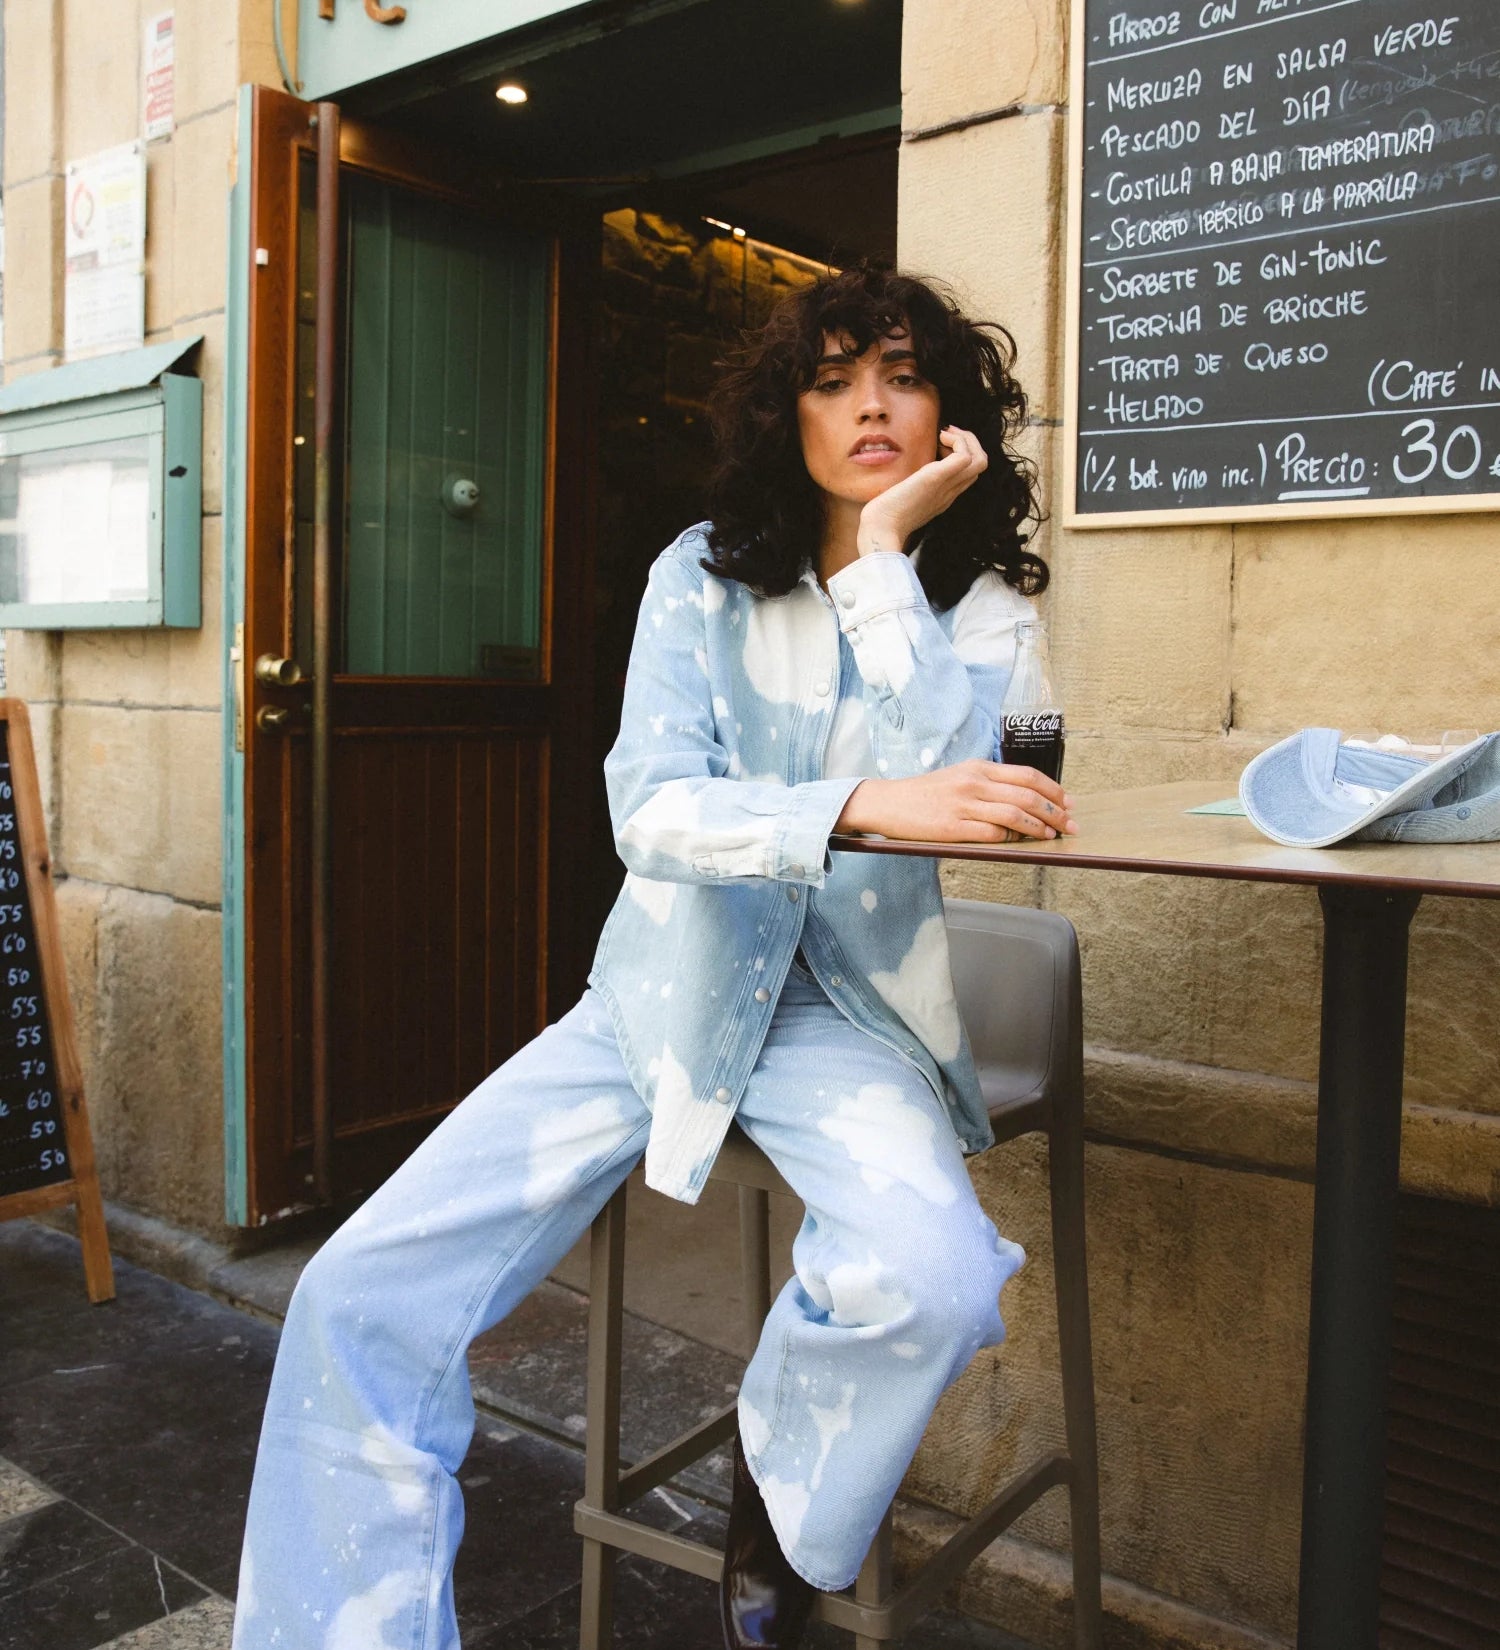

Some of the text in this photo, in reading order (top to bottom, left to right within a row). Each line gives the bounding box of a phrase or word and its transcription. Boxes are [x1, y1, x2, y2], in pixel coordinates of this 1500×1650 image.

[1108, 12, 1181, 48] ARROZ
[1199, 0, 1239, 30] CON
[1108, 17, 1459, 112] MERLUZA EN SALSA VERDE
[1101, 121, 1200, 157] PESCADO
[1219, 108, 1256, 138] DEL
[1283, 86, 1330, 125] DÍA
[1210, 162, 1223, 185] A
[1231, 151, 1281, 185] BAJA
[1298, 124, 1435, 172] TEMPERATURA
[1106, 218, 1189, 251] SECRETO
[1282, 193, 1295, 218] A
[1303, 187, 1324, 214] LA
[1100, 267, 1198, 303] SORBETE
[1214, 262, 1242, 285] DE
[1219, 303, 1247, 327] DE
[1098, 343, 1328, 382] TARTA DE QUESO
[1104, 391, 1206, 425] HELADO
[1129, 458, 1162, 490] bot.
[1173, 468, 1207, 491] vino
[1005, 709, 1061, 731] Coca-Cola
